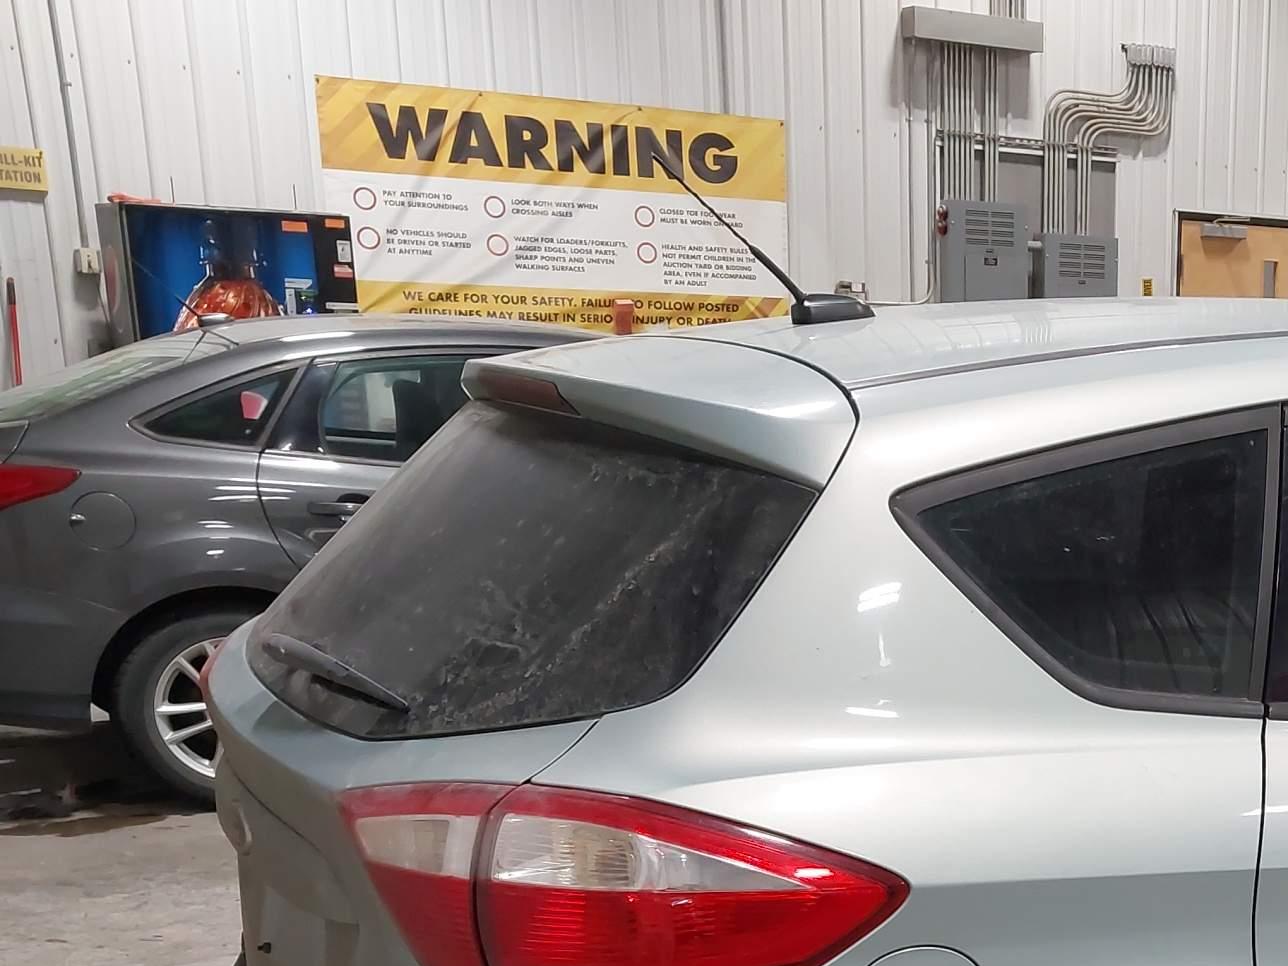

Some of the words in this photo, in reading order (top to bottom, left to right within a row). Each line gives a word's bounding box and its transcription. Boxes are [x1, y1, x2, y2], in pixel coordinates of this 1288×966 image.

[366, 102, 738, 184] WARNING
[400, 191, 440, 200] ATTENTION
[407, 201, 469, 211] SURROUNDINGS
[511, 199, 532, 207] LOOK
[534, 200, 553, 208] BOTH
[555, 201, 575, 209] WAYS
[577, 202, 599, 210] WHEN
[512, 209, 549, 217] CROSSING
[659, 208, 684, 216] CLOSED
[386, 228, 398, 236] NO
[400, 230, 434, 238] VEHICLES
[398, 239, 426, 247] DRIVEN
[442, 241, 472, 249] STARTED
[399, 248, 433, 256] ANYTIME
[705, 246, 728, 254] SAFETY
[704, 255, 735, 263] CHILDREN
[551, 265, 585, 273] SURFACES
[711, 273, 757, 281] ACCOMPANIED
[403, 290, 424, 301] WE
[428, 292, 460, 303] CARE
[464, 293, 488, 304] FOR
[492, 294, 528, 306] YOUR
[532, 296, 578, 308] SAFETY.
[581, 298, 615, 309] FAILU
[648, 300, 696, 312] FOLLOW
[698, 302, 740, 313] POSTED
[409, 308, 482, 318] GUIDELINES
[486, 310, 514, 320] MAY
[518, 312, 558, 323] RESULT
[562, 313, 576, 323] IN
[580, 313, 614, 324] SERIO
[632, 315, 673, 326] INJURY
[677, 315, 693, 326] OR
